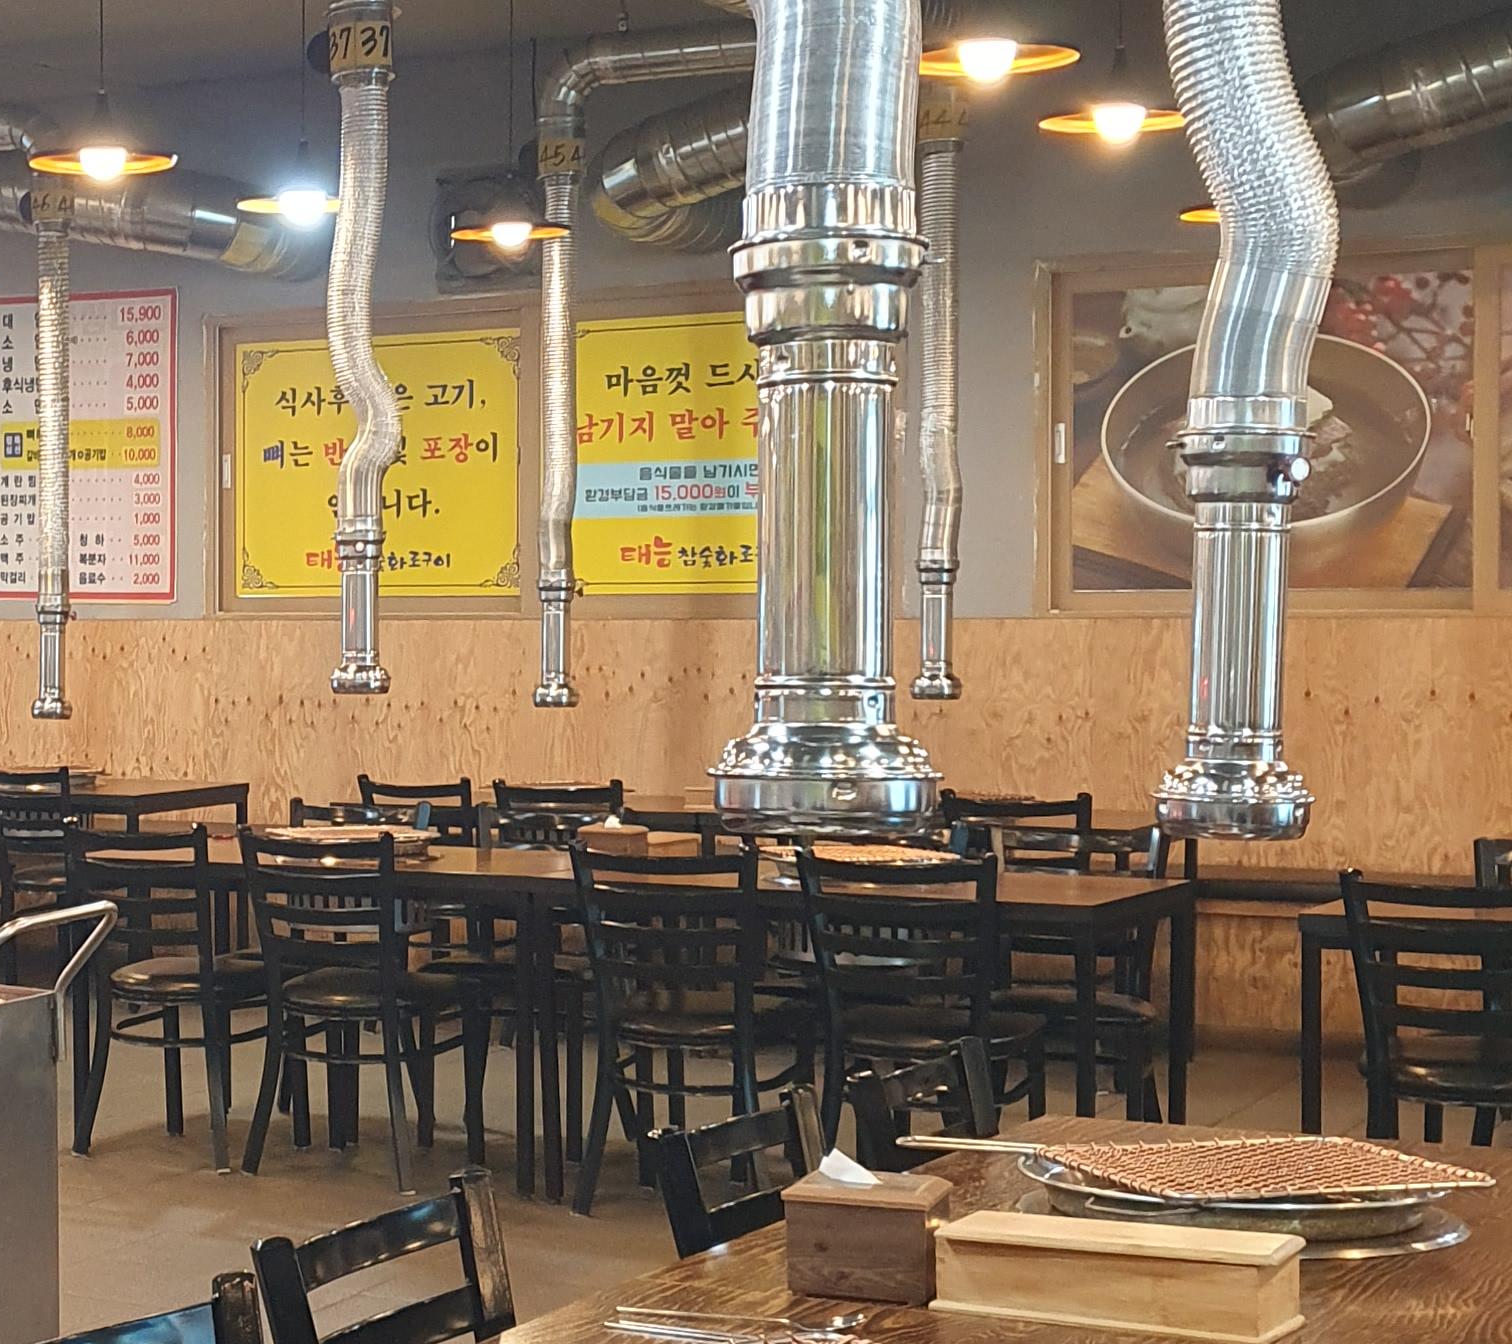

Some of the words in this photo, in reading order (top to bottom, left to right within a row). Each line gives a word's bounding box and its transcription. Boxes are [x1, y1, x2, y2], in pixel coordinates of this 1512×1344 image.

[360, 25, 390, 57] 37
[539, 144, 565, 167] 45
[119, 305, 162, 323] 15,900
[126, 329, 160, 346] 6,000
[126, 352, 159, 368] 7,000
[126, 373, 159, 389] 4,000
[605, 362, 692, 398] 마음껏
[424, 379, 487, 410] 고기,
[126, 395, 159, 411] 5,000
[669, 407, 730, 441] 말아
[126, 426, 155, 439] 8,000
[124, 448, 156, 462] 10,000
[263, 439, 313, 469] 뼈는
[420, 431, 499, 463] 포장이
[133, 473, 160, 486] 4,000
[639, 465, 697, 481] 음식물을
[133, 493, 161, 505] 3,000
[585, 487, 648, 503] 환경부담금
[134, 513, 161, 525] 1,000
[133, 534, 160, 546] 5,000
[129, 553, 160, 566] 11,000
[619, 535, 673, 568] 태능
[677, 544, 759, 570] 참숯화로
[79, 572, 106, 586] 음료수
[133, 572, 160, 586] 2,000
